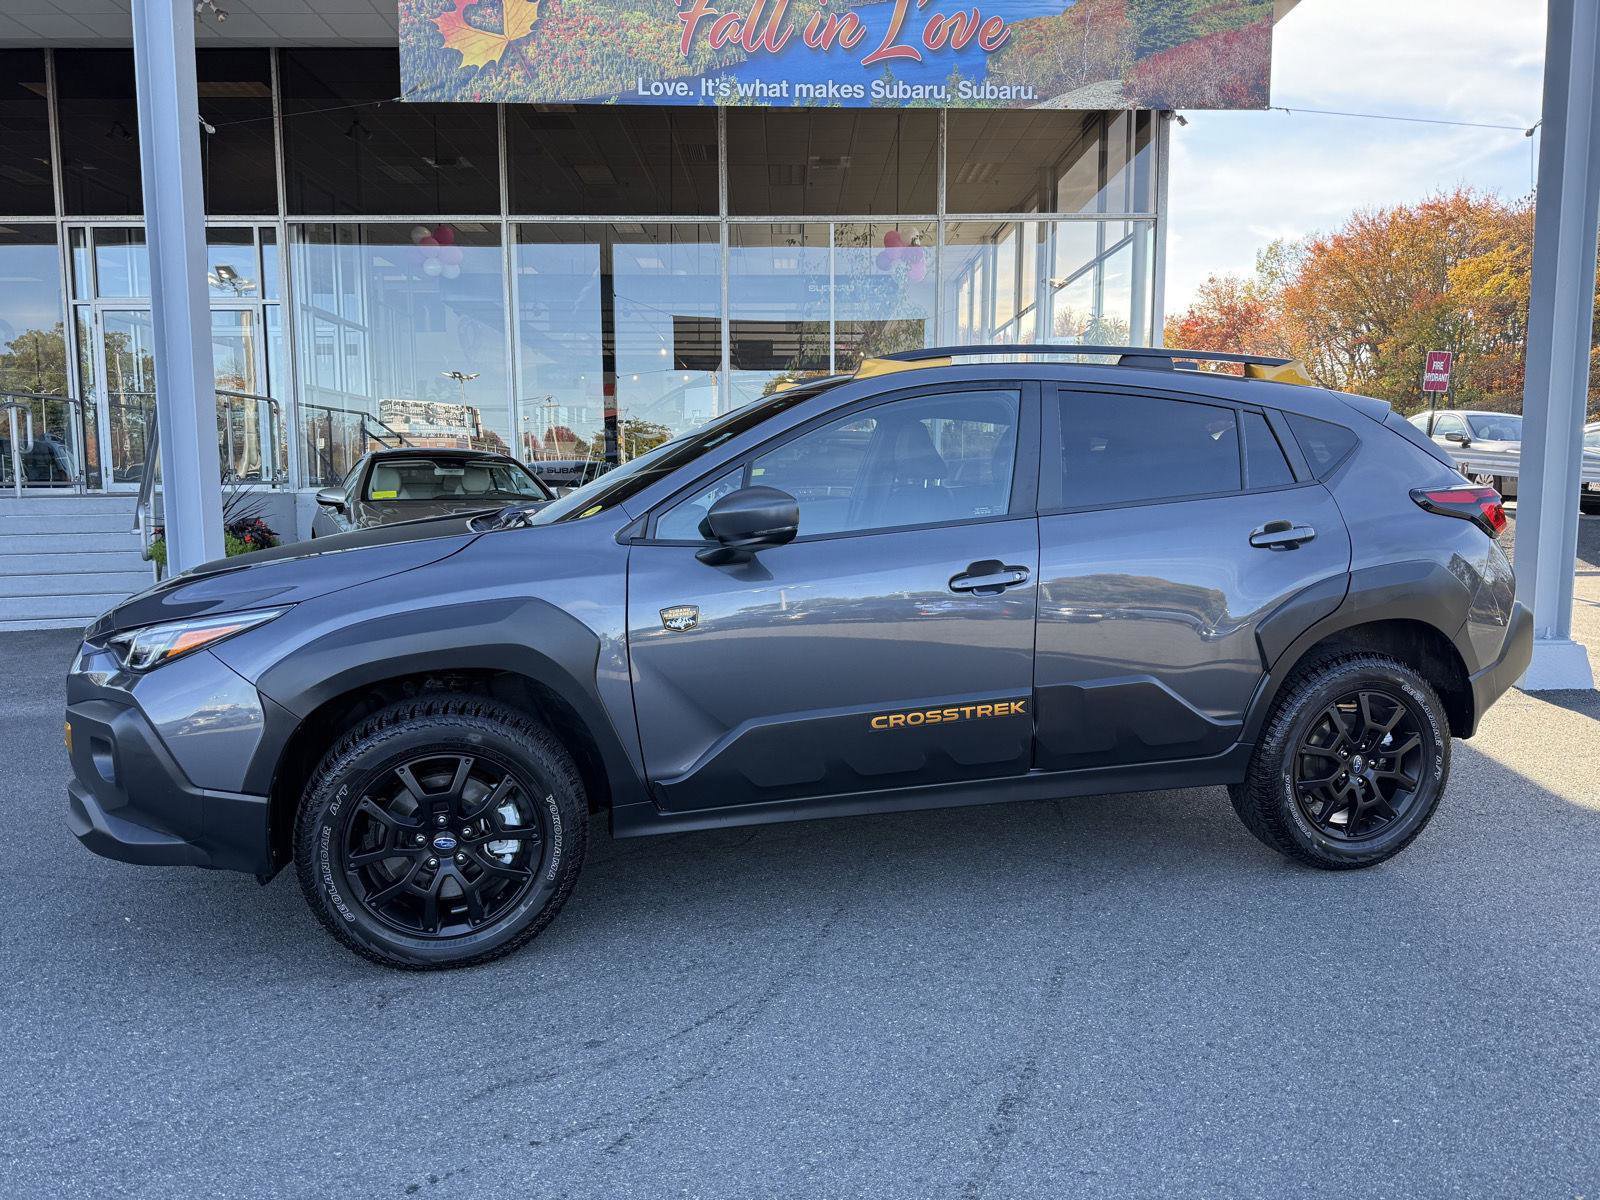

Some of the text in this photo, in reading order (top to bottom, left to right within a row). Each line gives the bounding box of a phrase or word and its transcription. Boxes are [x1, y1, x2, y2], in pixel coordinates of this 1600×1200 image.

[674, 0, 1011, 65] Fall in Love
[637, 77, 1039, 102] Love. It's what makes Subaru, Subaru.
[1424, 372, 1449, 382] HYDRANT
[1432, 361, 1445, 370] FIRE
[870, 700, 1027, 729] CROSSTREK
[546, 794, 563, 881] YOKOHAMA
[320, 783, 356, 922] GEOLANDAR A/T
